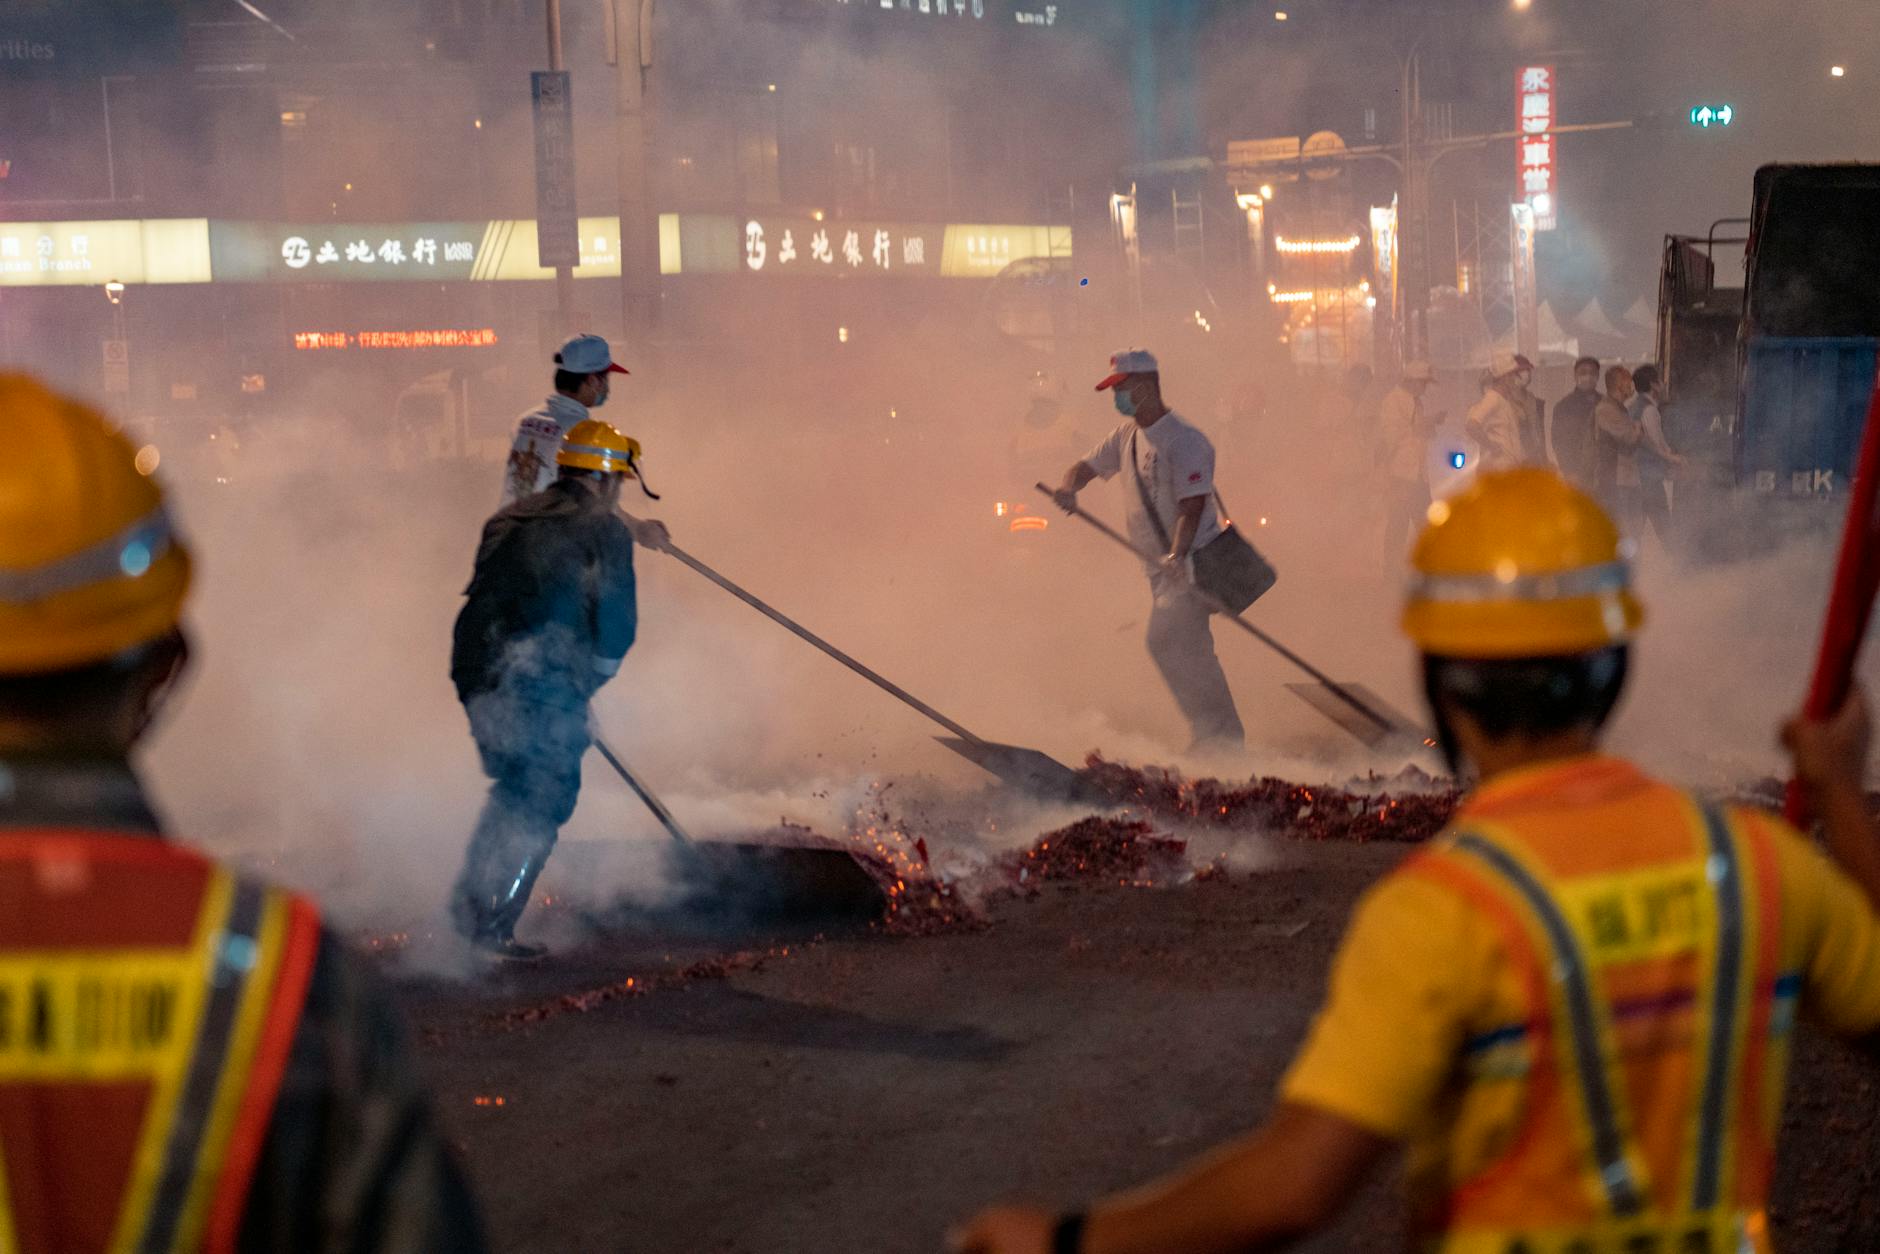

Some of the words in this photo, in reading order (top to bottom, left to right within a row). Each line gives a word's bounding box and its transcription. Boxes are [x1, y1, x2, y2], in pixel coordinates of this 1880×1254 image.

[316, 237, 437, 265] 土地銀行
[779, 229, 890, 269] 土地銀行
